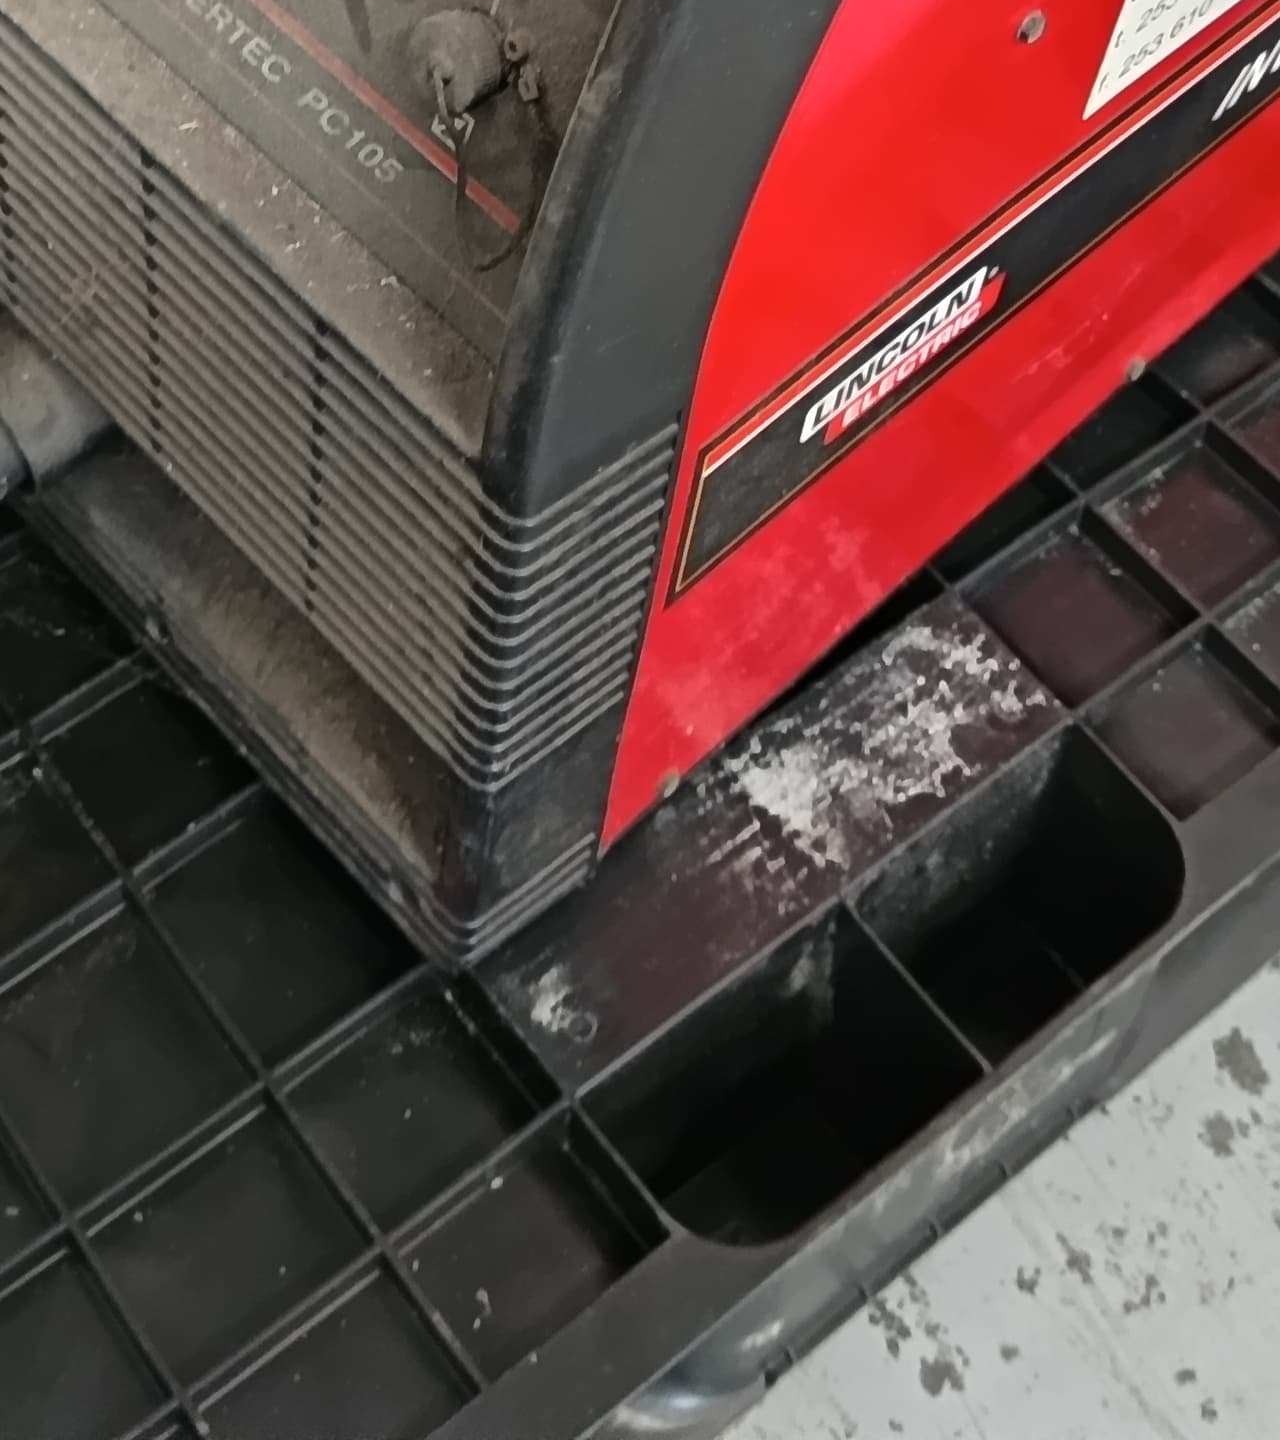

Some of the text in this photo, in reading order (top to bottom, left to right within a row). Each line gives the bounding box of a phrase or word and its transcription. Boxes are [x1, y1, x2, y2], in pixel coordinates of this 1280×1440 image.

[1118, 32, 1164, 78] 253
[297, 87, 404, 183] PC105
[807, 274, 979, 435] LINCOLN
[842, 301, 983, 428] ELECTRIC
